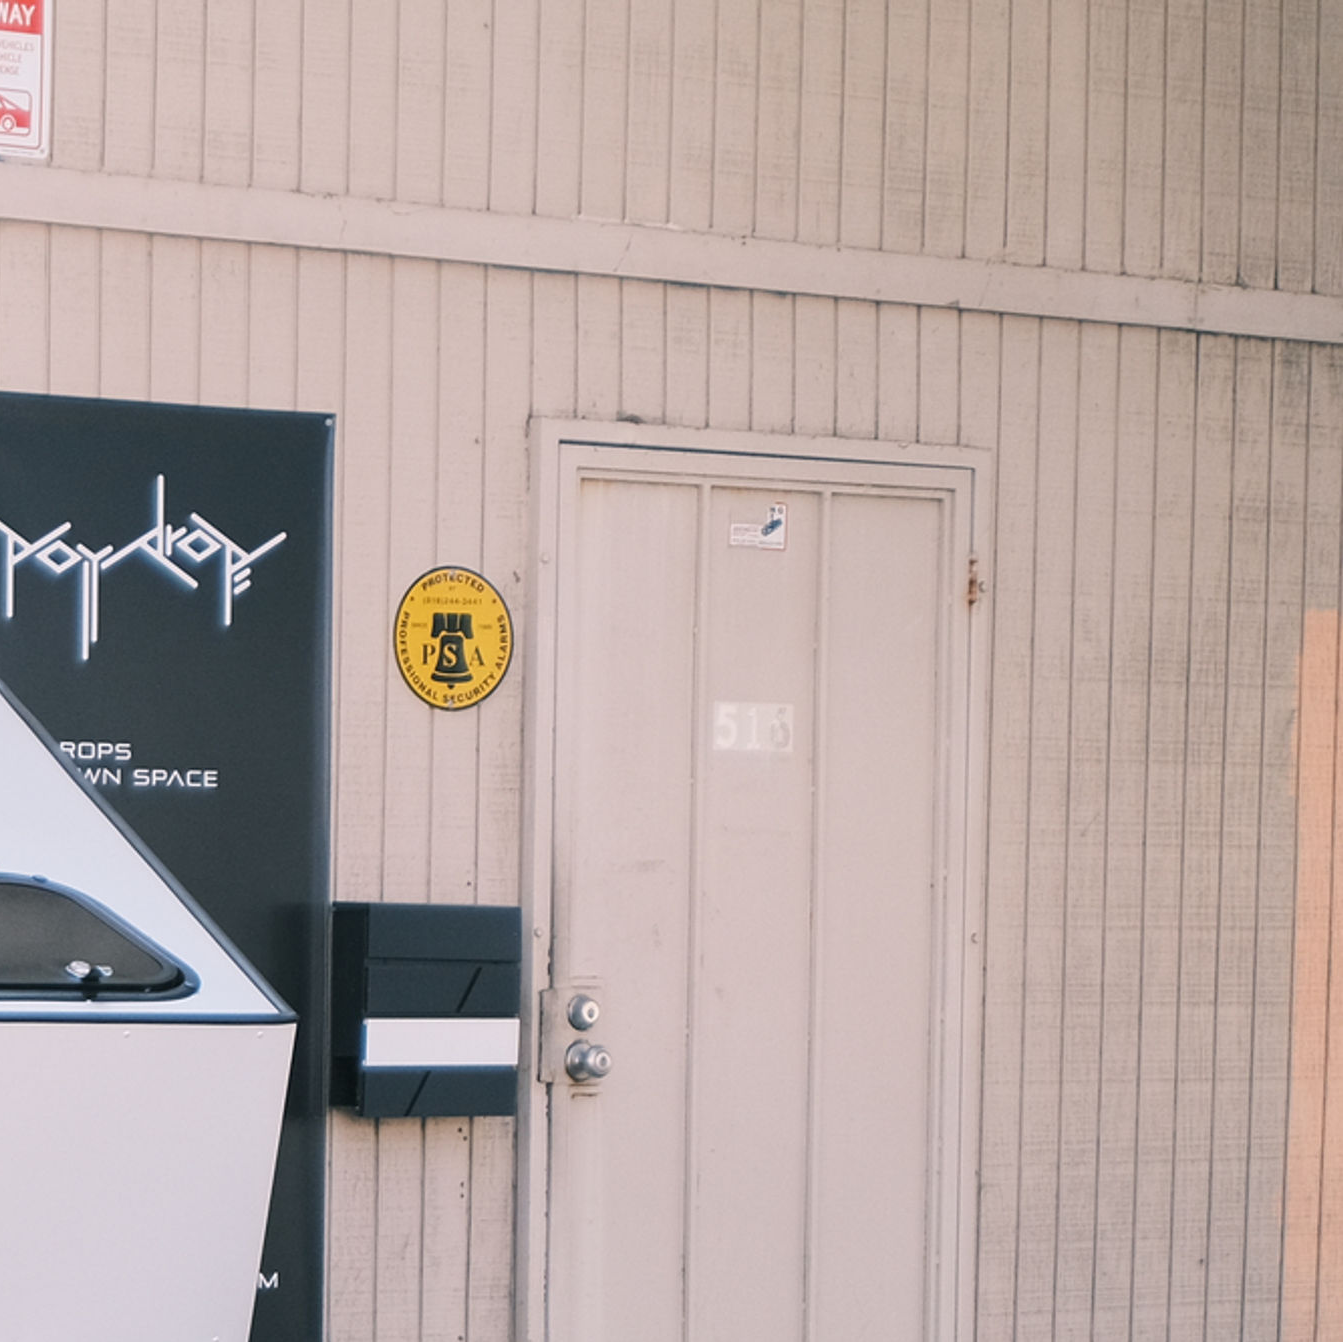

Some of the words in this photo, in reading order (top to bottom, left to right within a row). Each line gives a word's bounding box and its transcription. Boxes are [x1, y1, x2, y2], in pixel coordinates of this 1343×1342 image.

[422, 573, 485, 593] PROTECTED
[399, 610, 439, 701] PROFESSIONAL
[442, 672, 497, 704] SECURITY
[495, 614, 509, 672] ALARMS
[133, 769, 219, 787] SPACE
